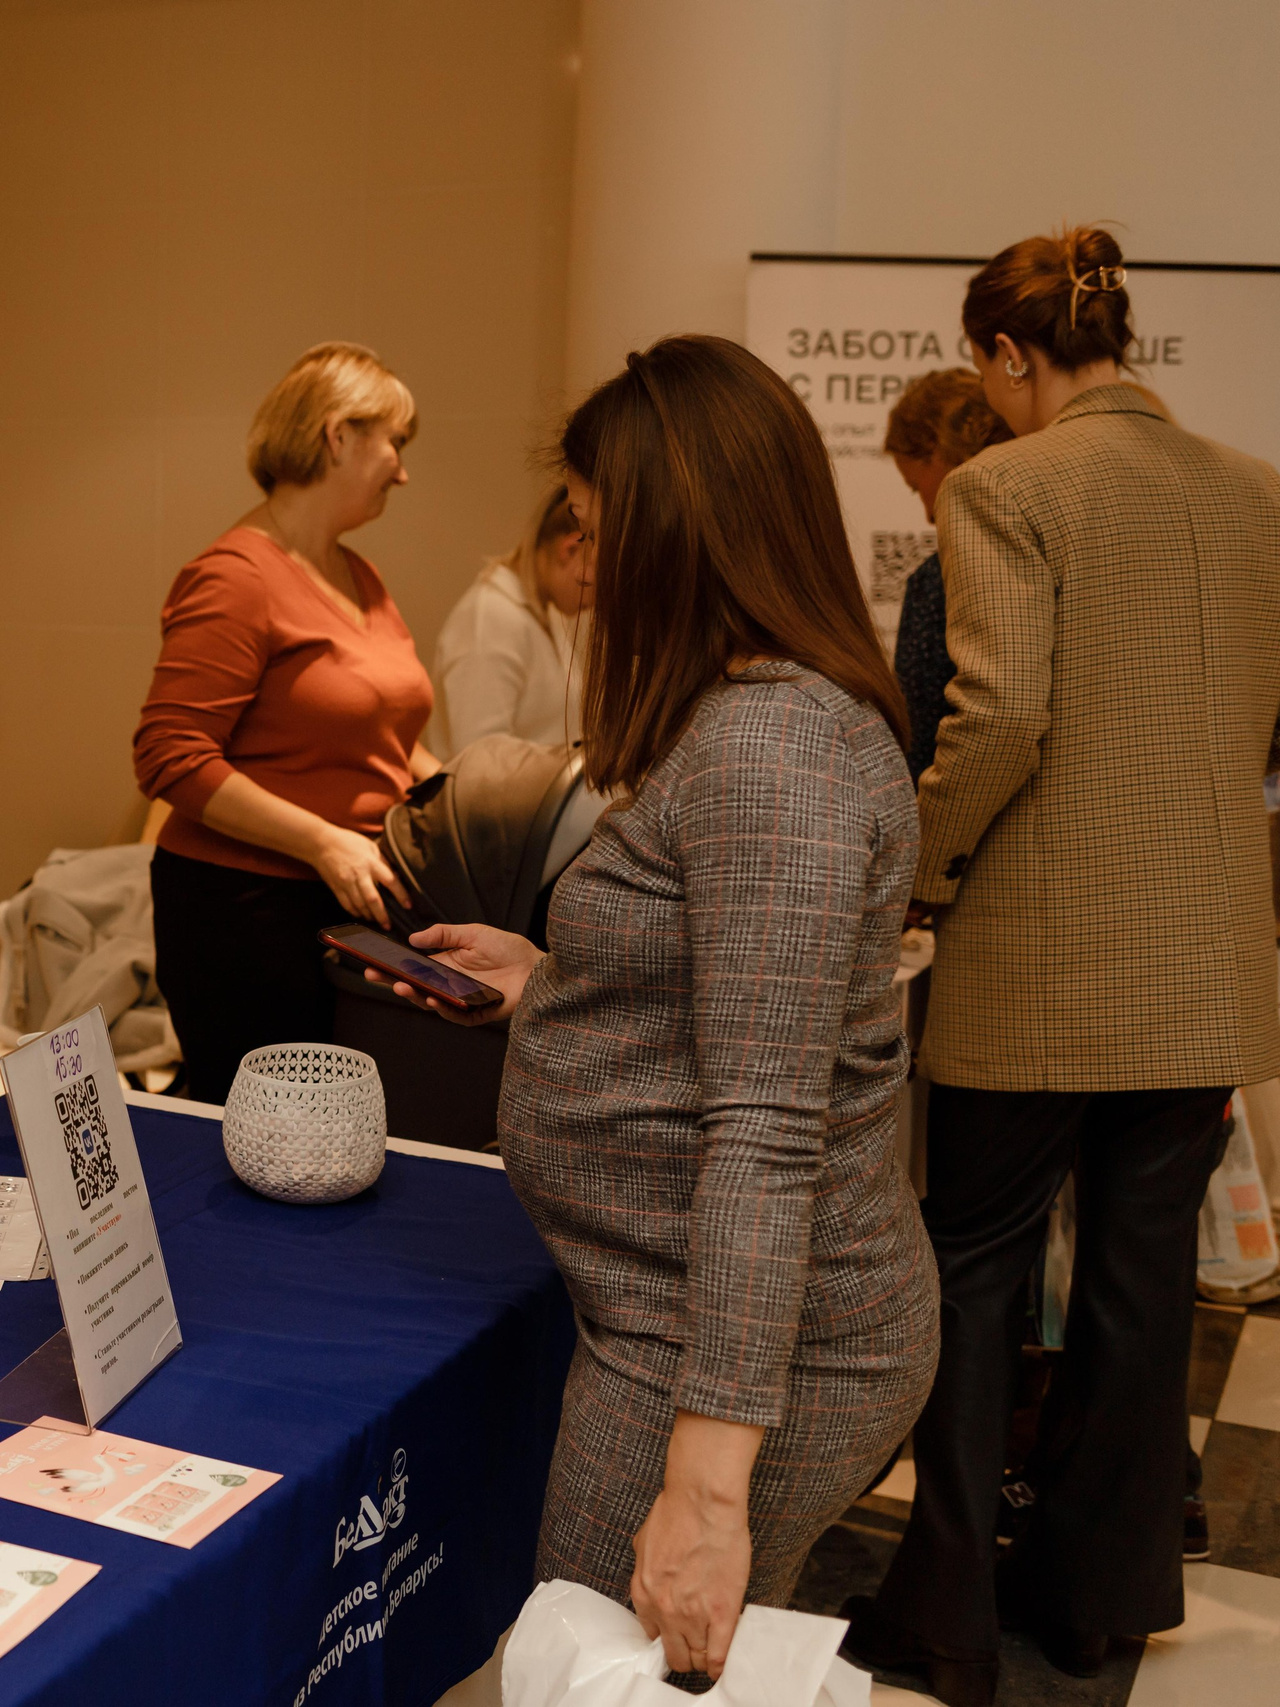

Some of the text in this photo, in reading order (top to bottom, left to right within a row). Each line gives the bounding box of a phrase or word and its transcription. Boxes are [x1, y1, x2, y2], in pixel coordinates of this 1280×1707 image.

[788, 328, 943, 361] ЗАБОТА
[50, 1028, 79, 1055] 13:00
[55, 1054, 82, 1082] 15:30
[89, 1202, 114, 1224] последним
[123, 1183, 138, 1199] постом
[73, 1233, 96, 1255] напишите
[80, 1241, 129, 1285] Покажите свою запись
[86, 1253, 154, 1315] Получите персональный номер
[90, 1305, 115, 1332] участника
[97, 1295, 165, 1360] Станьте участником розыгрыша
